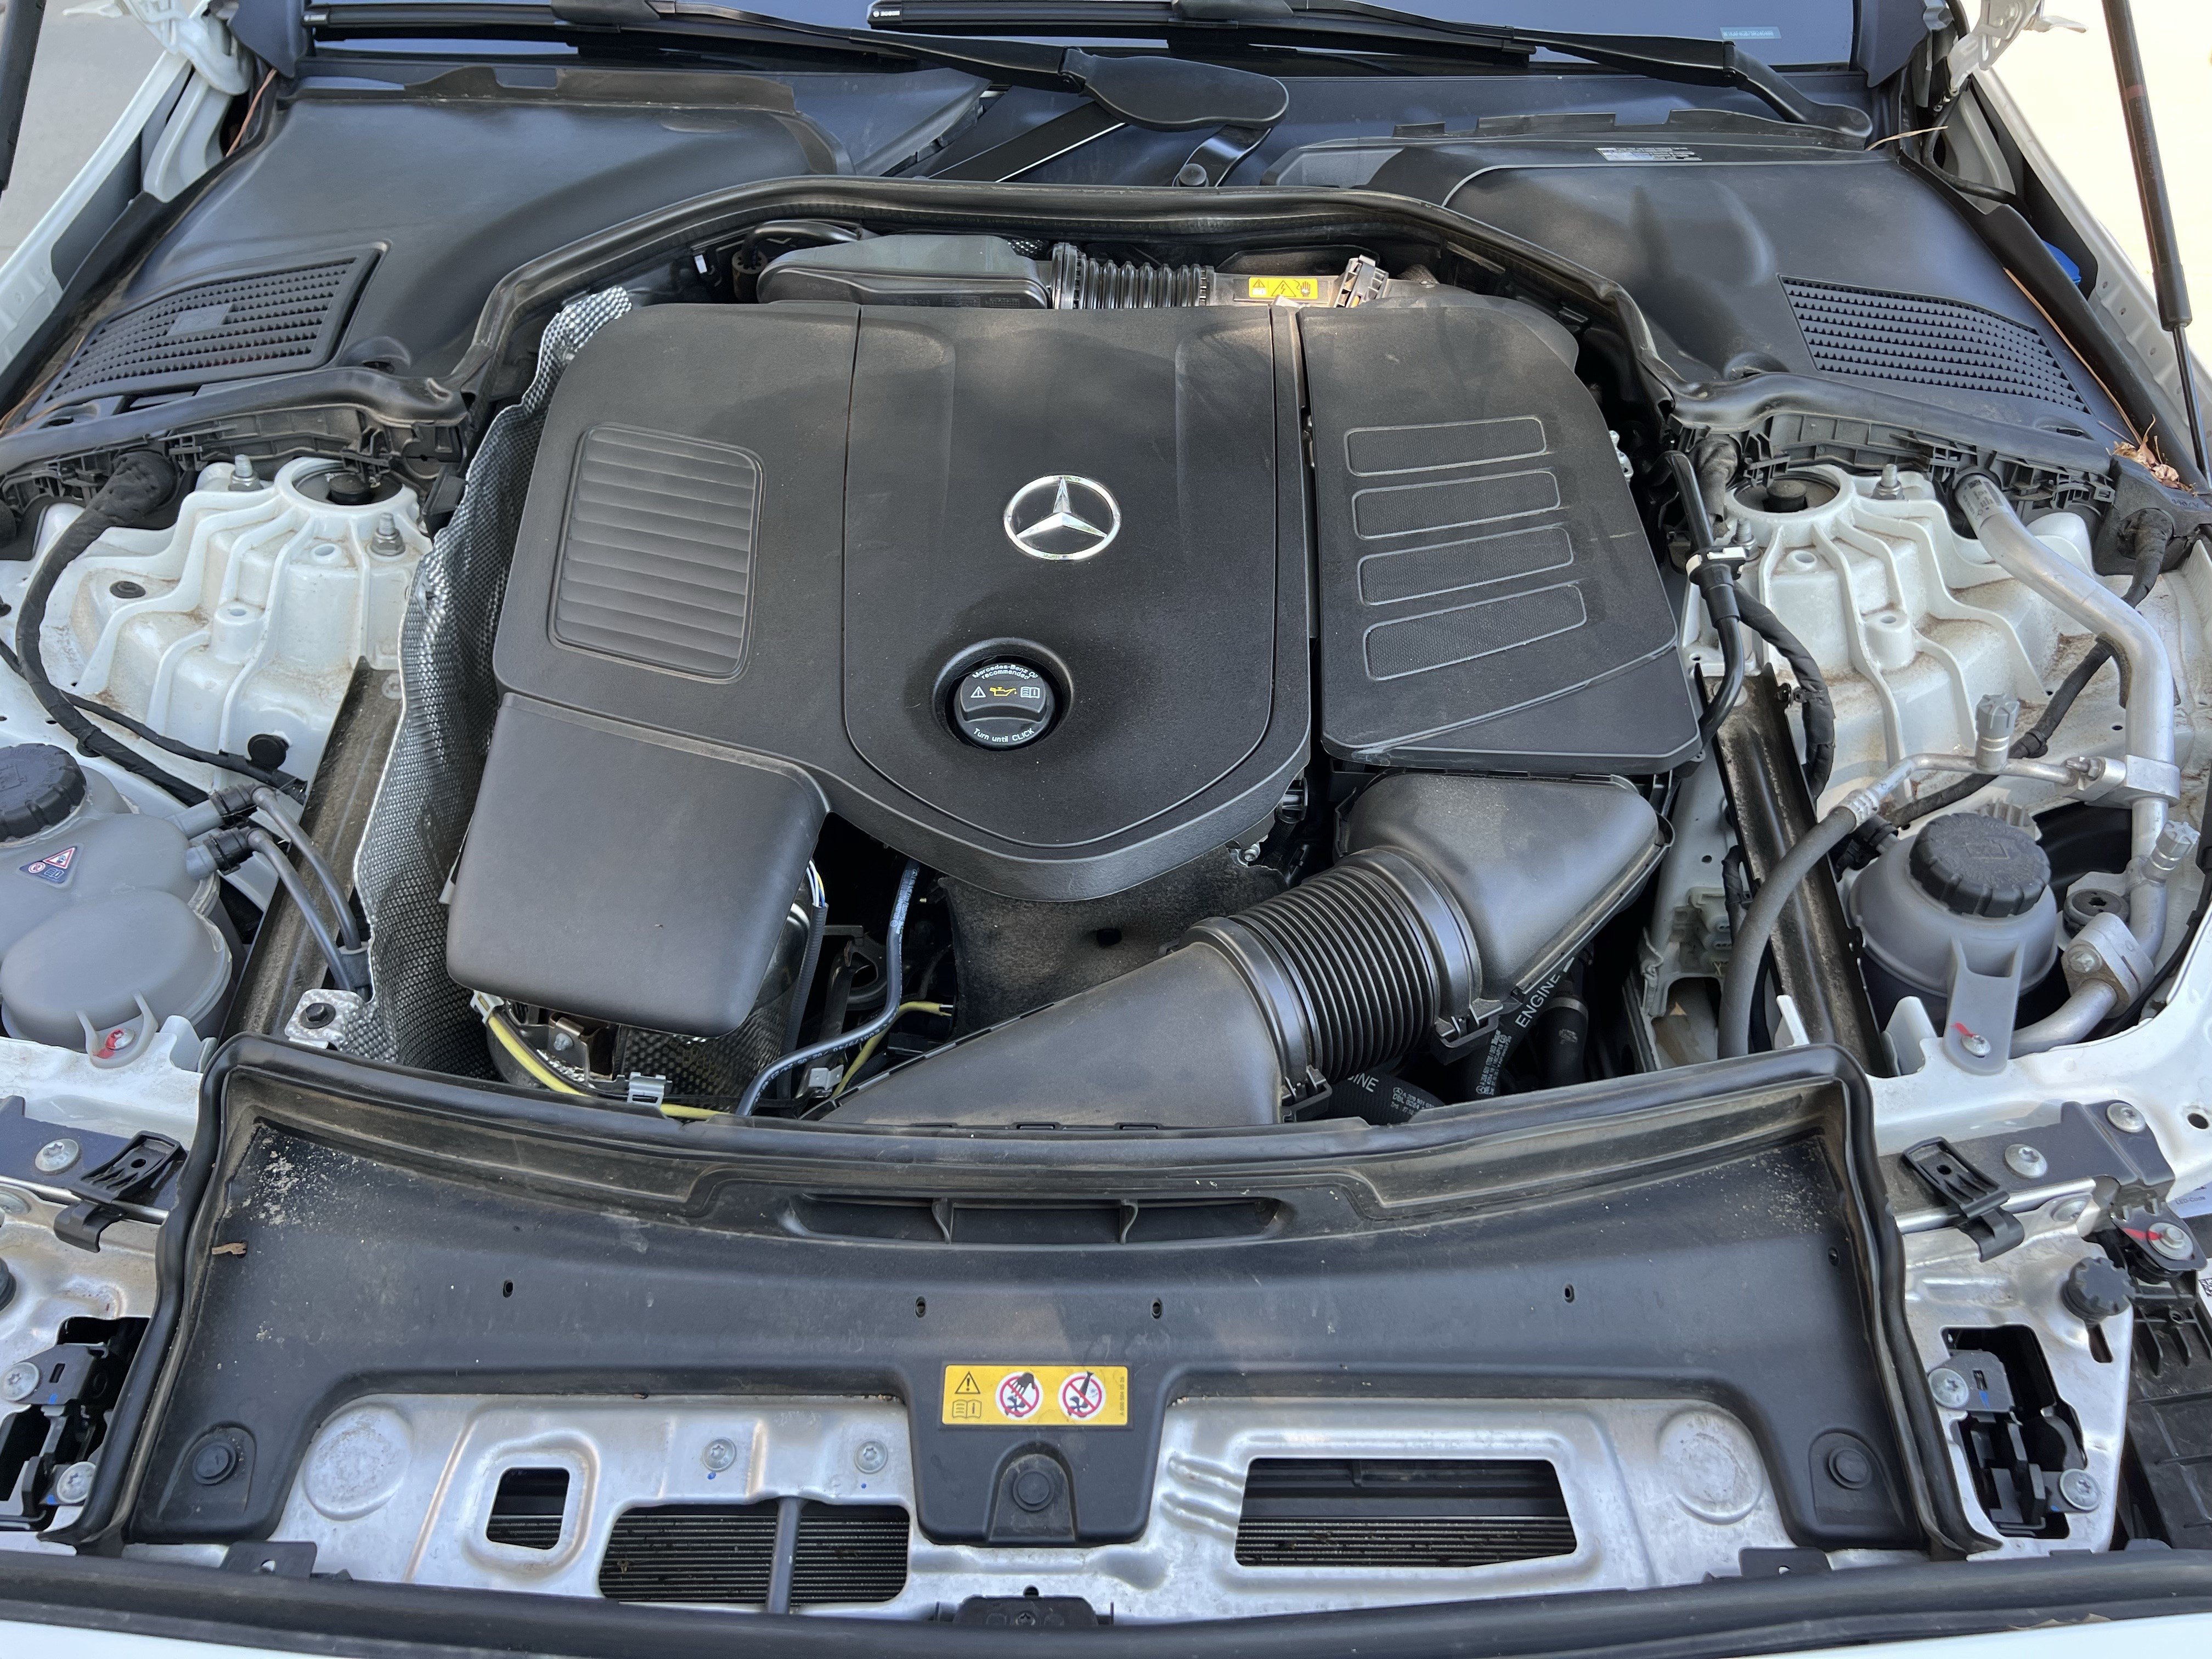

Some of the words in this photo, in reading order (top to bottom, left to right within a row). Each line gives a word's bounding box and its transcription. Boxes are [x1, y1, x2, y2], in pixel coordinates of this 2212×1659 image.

[973, 664, 1028, 679] Mercedes-Benz
[981, 669, 1031, 680] recommended
[974, 727, 990, 741] Turn
[1012, 728, 1035, 742] CLICK
[1515, 974, 1561, 1028] ENGINE
